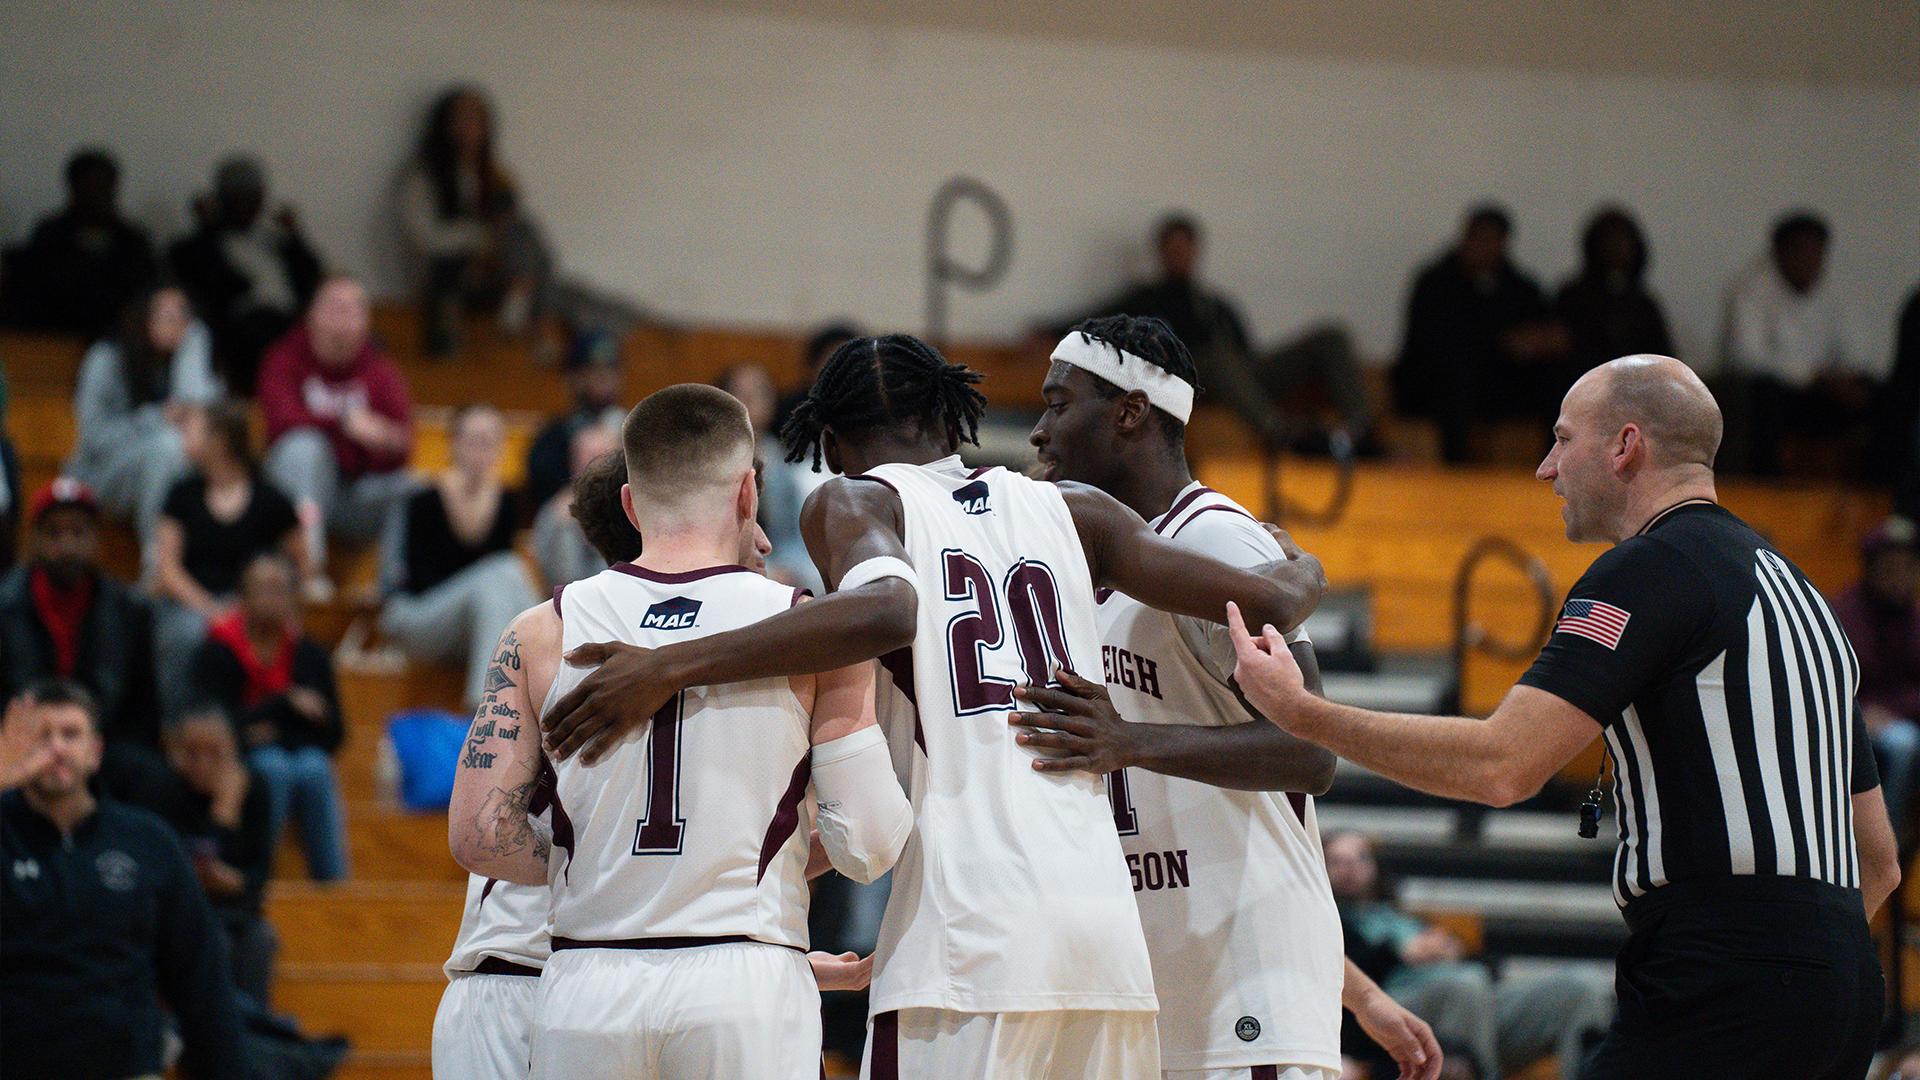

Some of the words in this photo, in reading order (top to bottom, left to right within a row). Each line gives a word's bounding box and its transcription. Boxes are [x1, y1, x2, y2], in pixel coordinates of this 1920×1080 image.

[644, 612, 696, 628] MAC
[941, 548, 1078, 718] 20
[492, 643, 523, 671] Lord
[498, 724, 521, 741] not
[462, 737, 498, 770] Fear
[632, 689, 686, 856] 1
